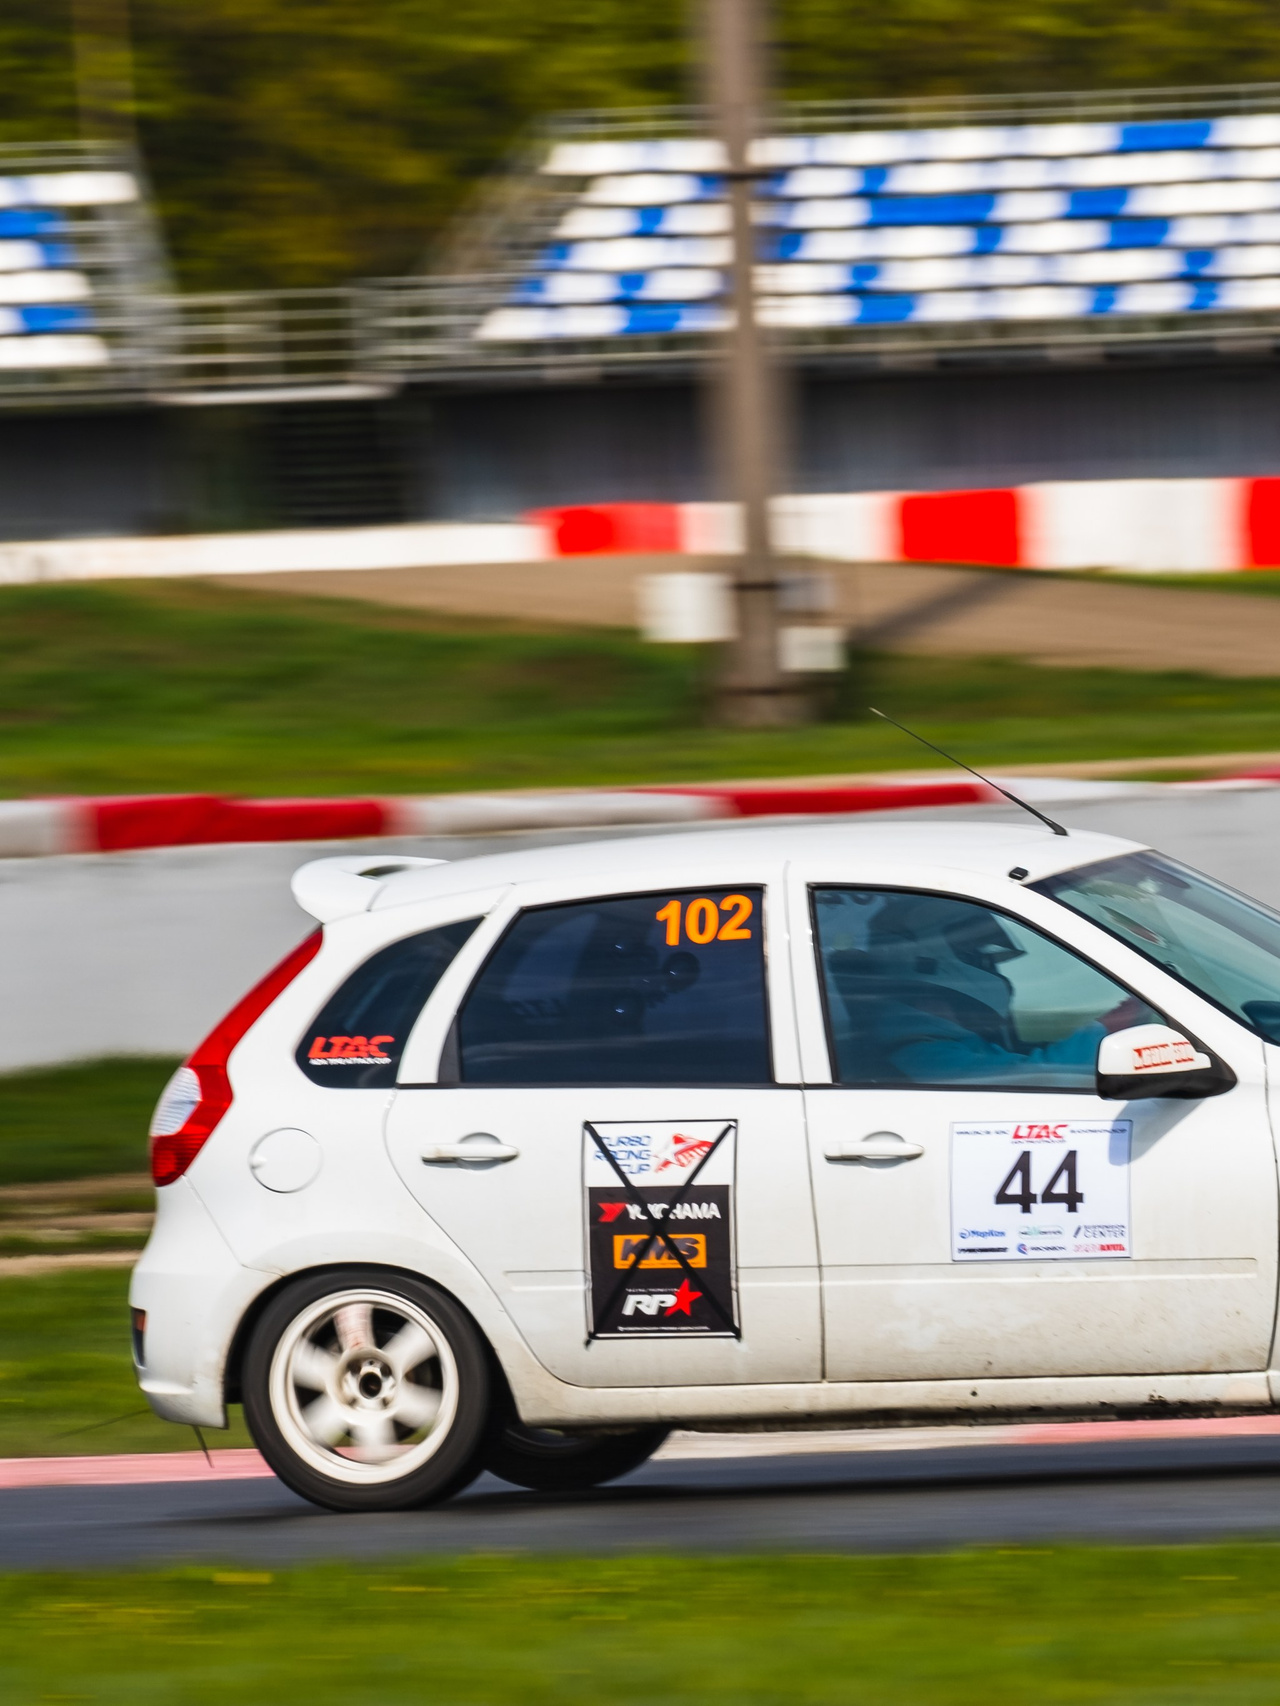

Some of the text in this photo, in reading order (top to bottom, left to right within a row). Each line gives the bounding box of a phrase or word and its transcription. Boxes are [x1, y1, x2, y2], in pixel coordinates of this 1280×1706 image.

[656, 893, 753, 946] 102
[308, 1035, 395, 1058] LTAC
[1013, 1124, 1068, 1139] LTAC
[995, 1150, 1084, 1214] 44
[620, 1237, 700, 1261] KMS
